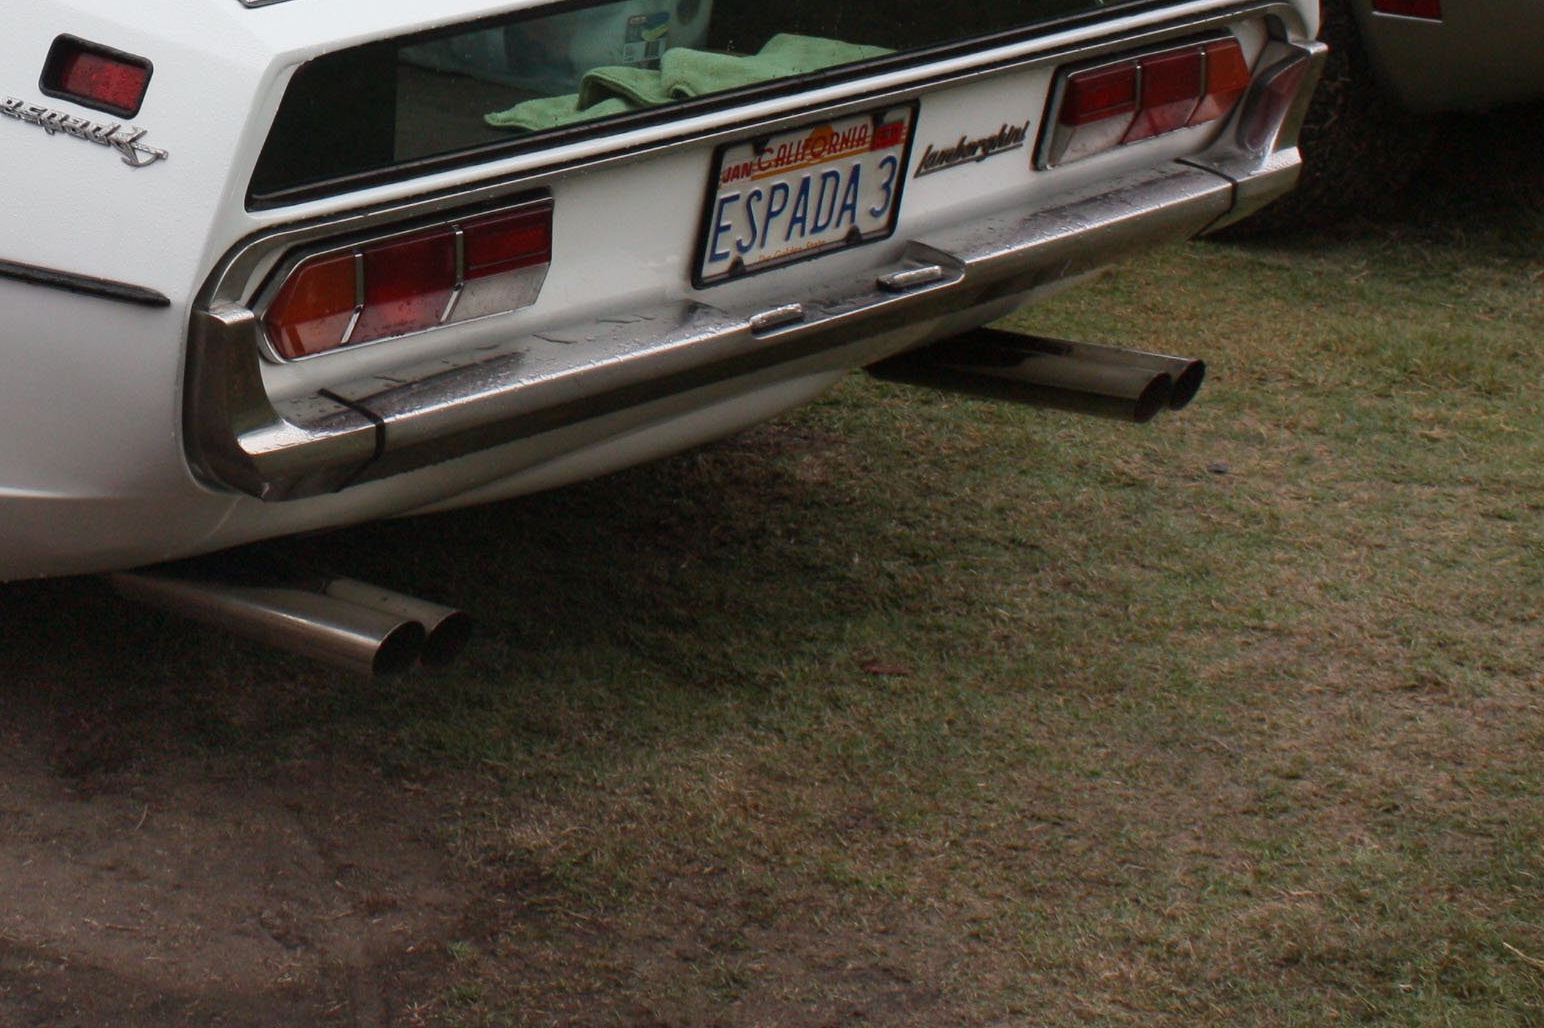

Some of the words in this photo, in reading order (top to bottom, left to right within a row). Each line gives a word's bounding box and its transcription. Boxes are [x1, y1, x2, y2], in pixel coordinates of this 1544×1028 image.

[721, 160, 753, 184] JAN
[757, 123, 869, 172] CALIFORNIA
[709, 163, 861, 263] ESPADA
[868, 154, 899, 219] 3
